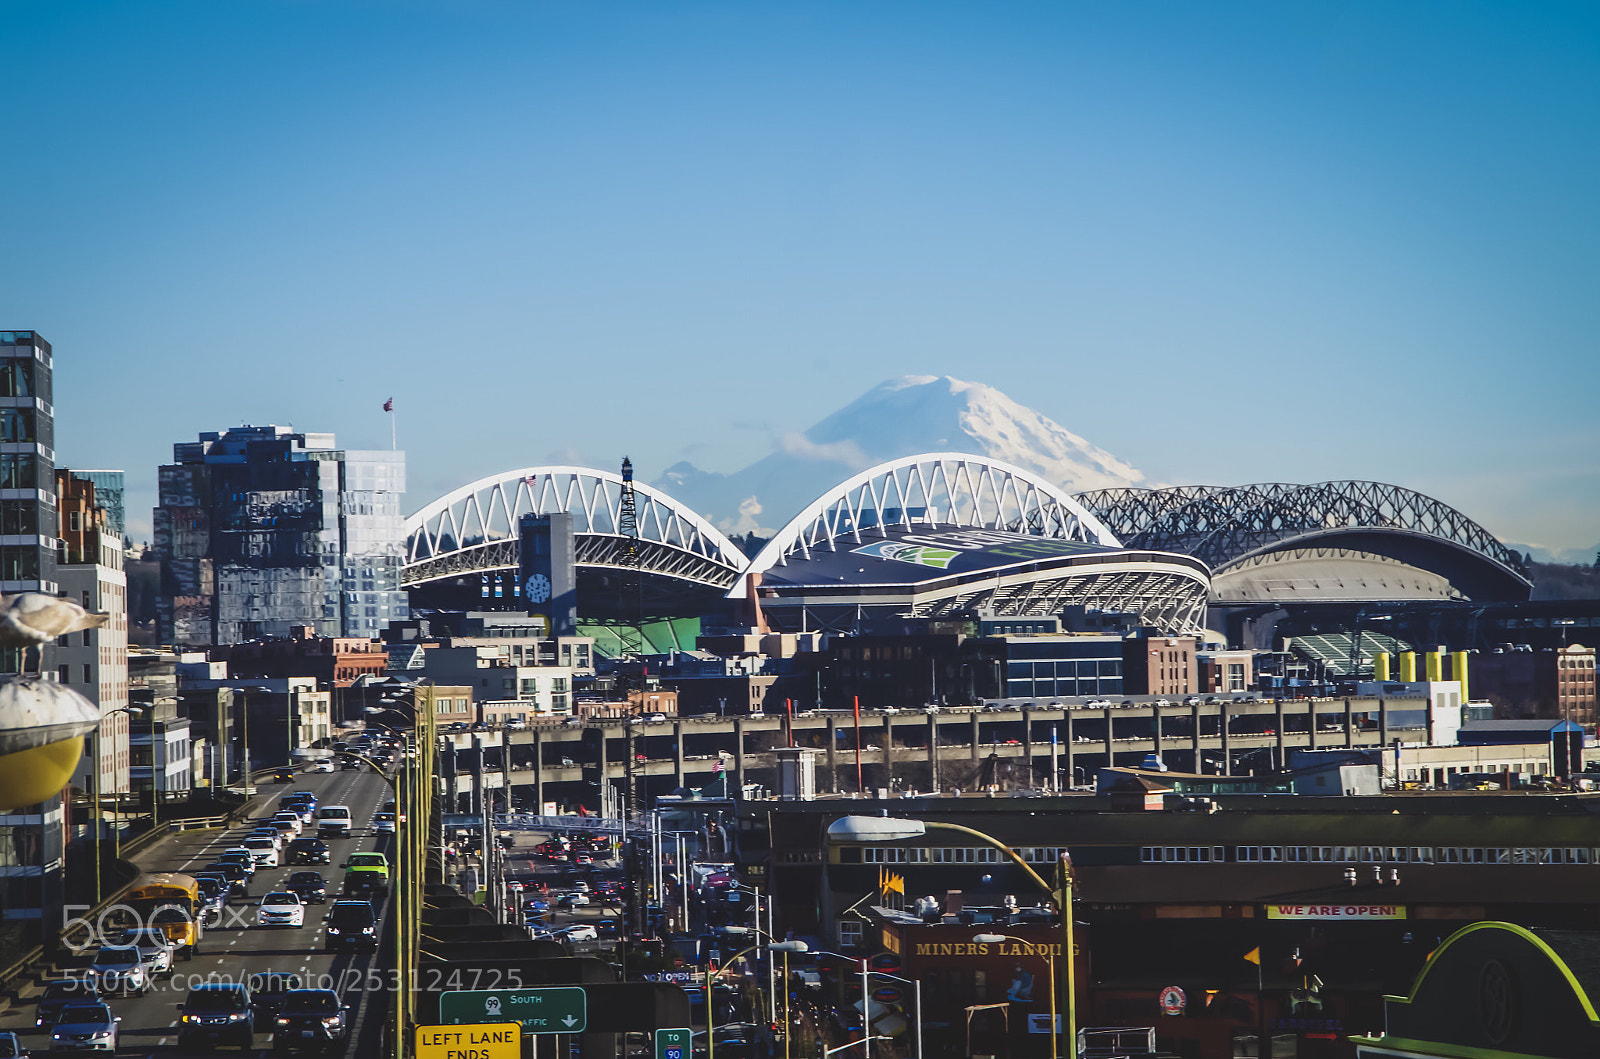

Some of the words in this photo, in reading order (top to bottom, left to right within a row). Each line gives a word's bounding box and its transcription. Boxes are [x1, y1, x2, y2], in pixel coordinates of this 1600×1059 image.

[1278, 905, 1303, 915] WE
[1308, 905, 1340, 916] ARE
[1345, 905, 1396, 916] OPEN!
[916, 943, 989, 956] MINERS
[999, 943, 1080, 957] LANDIG
[487, 999, 498, 1009] 99
[423, 1033, 462, 1045] LEFT
[470, 1031, 513, 1044] LANE
[447, 1049, 490, 1059] ENDS
[667, 1050, 680, 1059] 90
